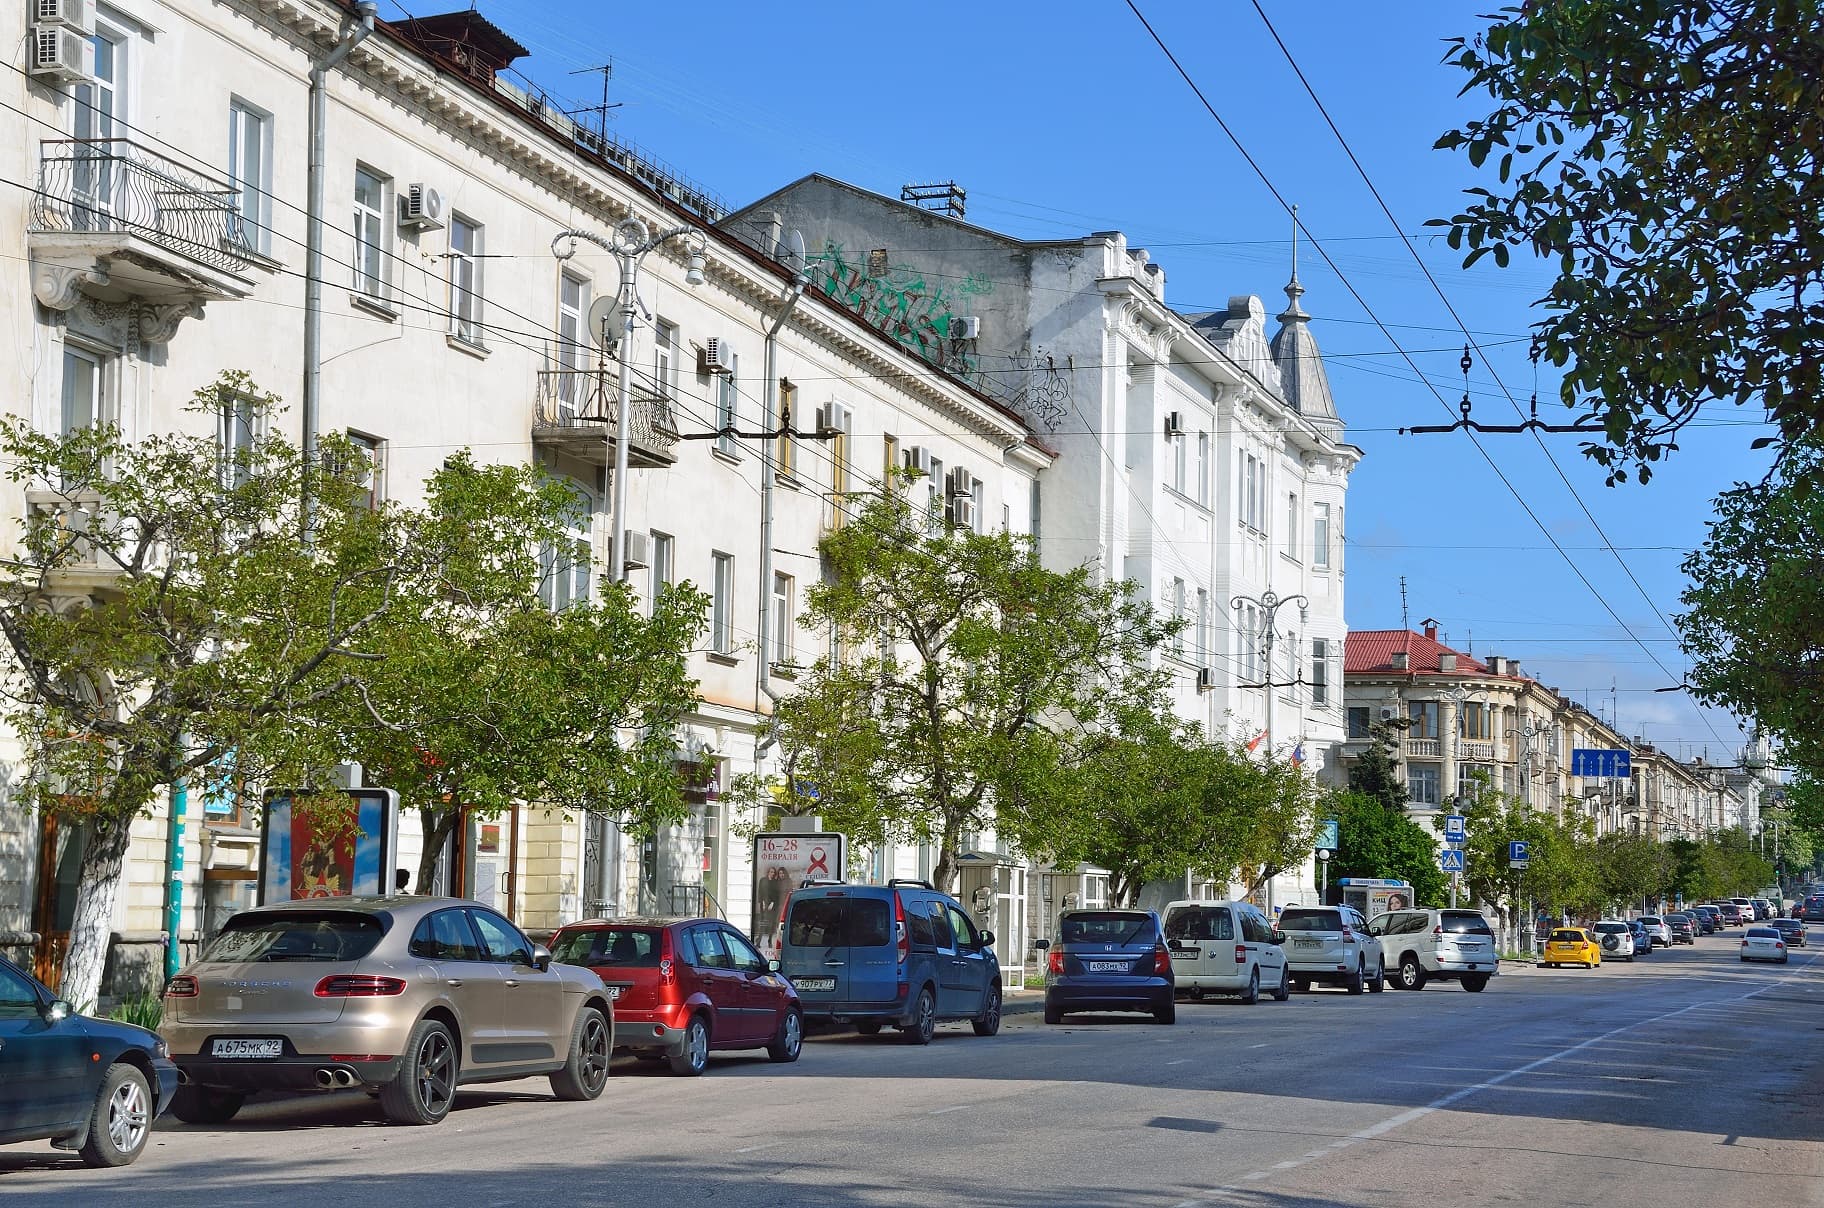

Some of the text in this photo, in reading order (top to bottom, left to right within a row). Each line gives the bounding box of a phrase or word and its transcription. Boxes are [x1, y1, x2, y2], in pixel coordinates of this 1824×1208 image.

[761, 853, 798, 861] ФЕВРАЛЯ
[216, 1039, 279, 1054] А675МК 92
